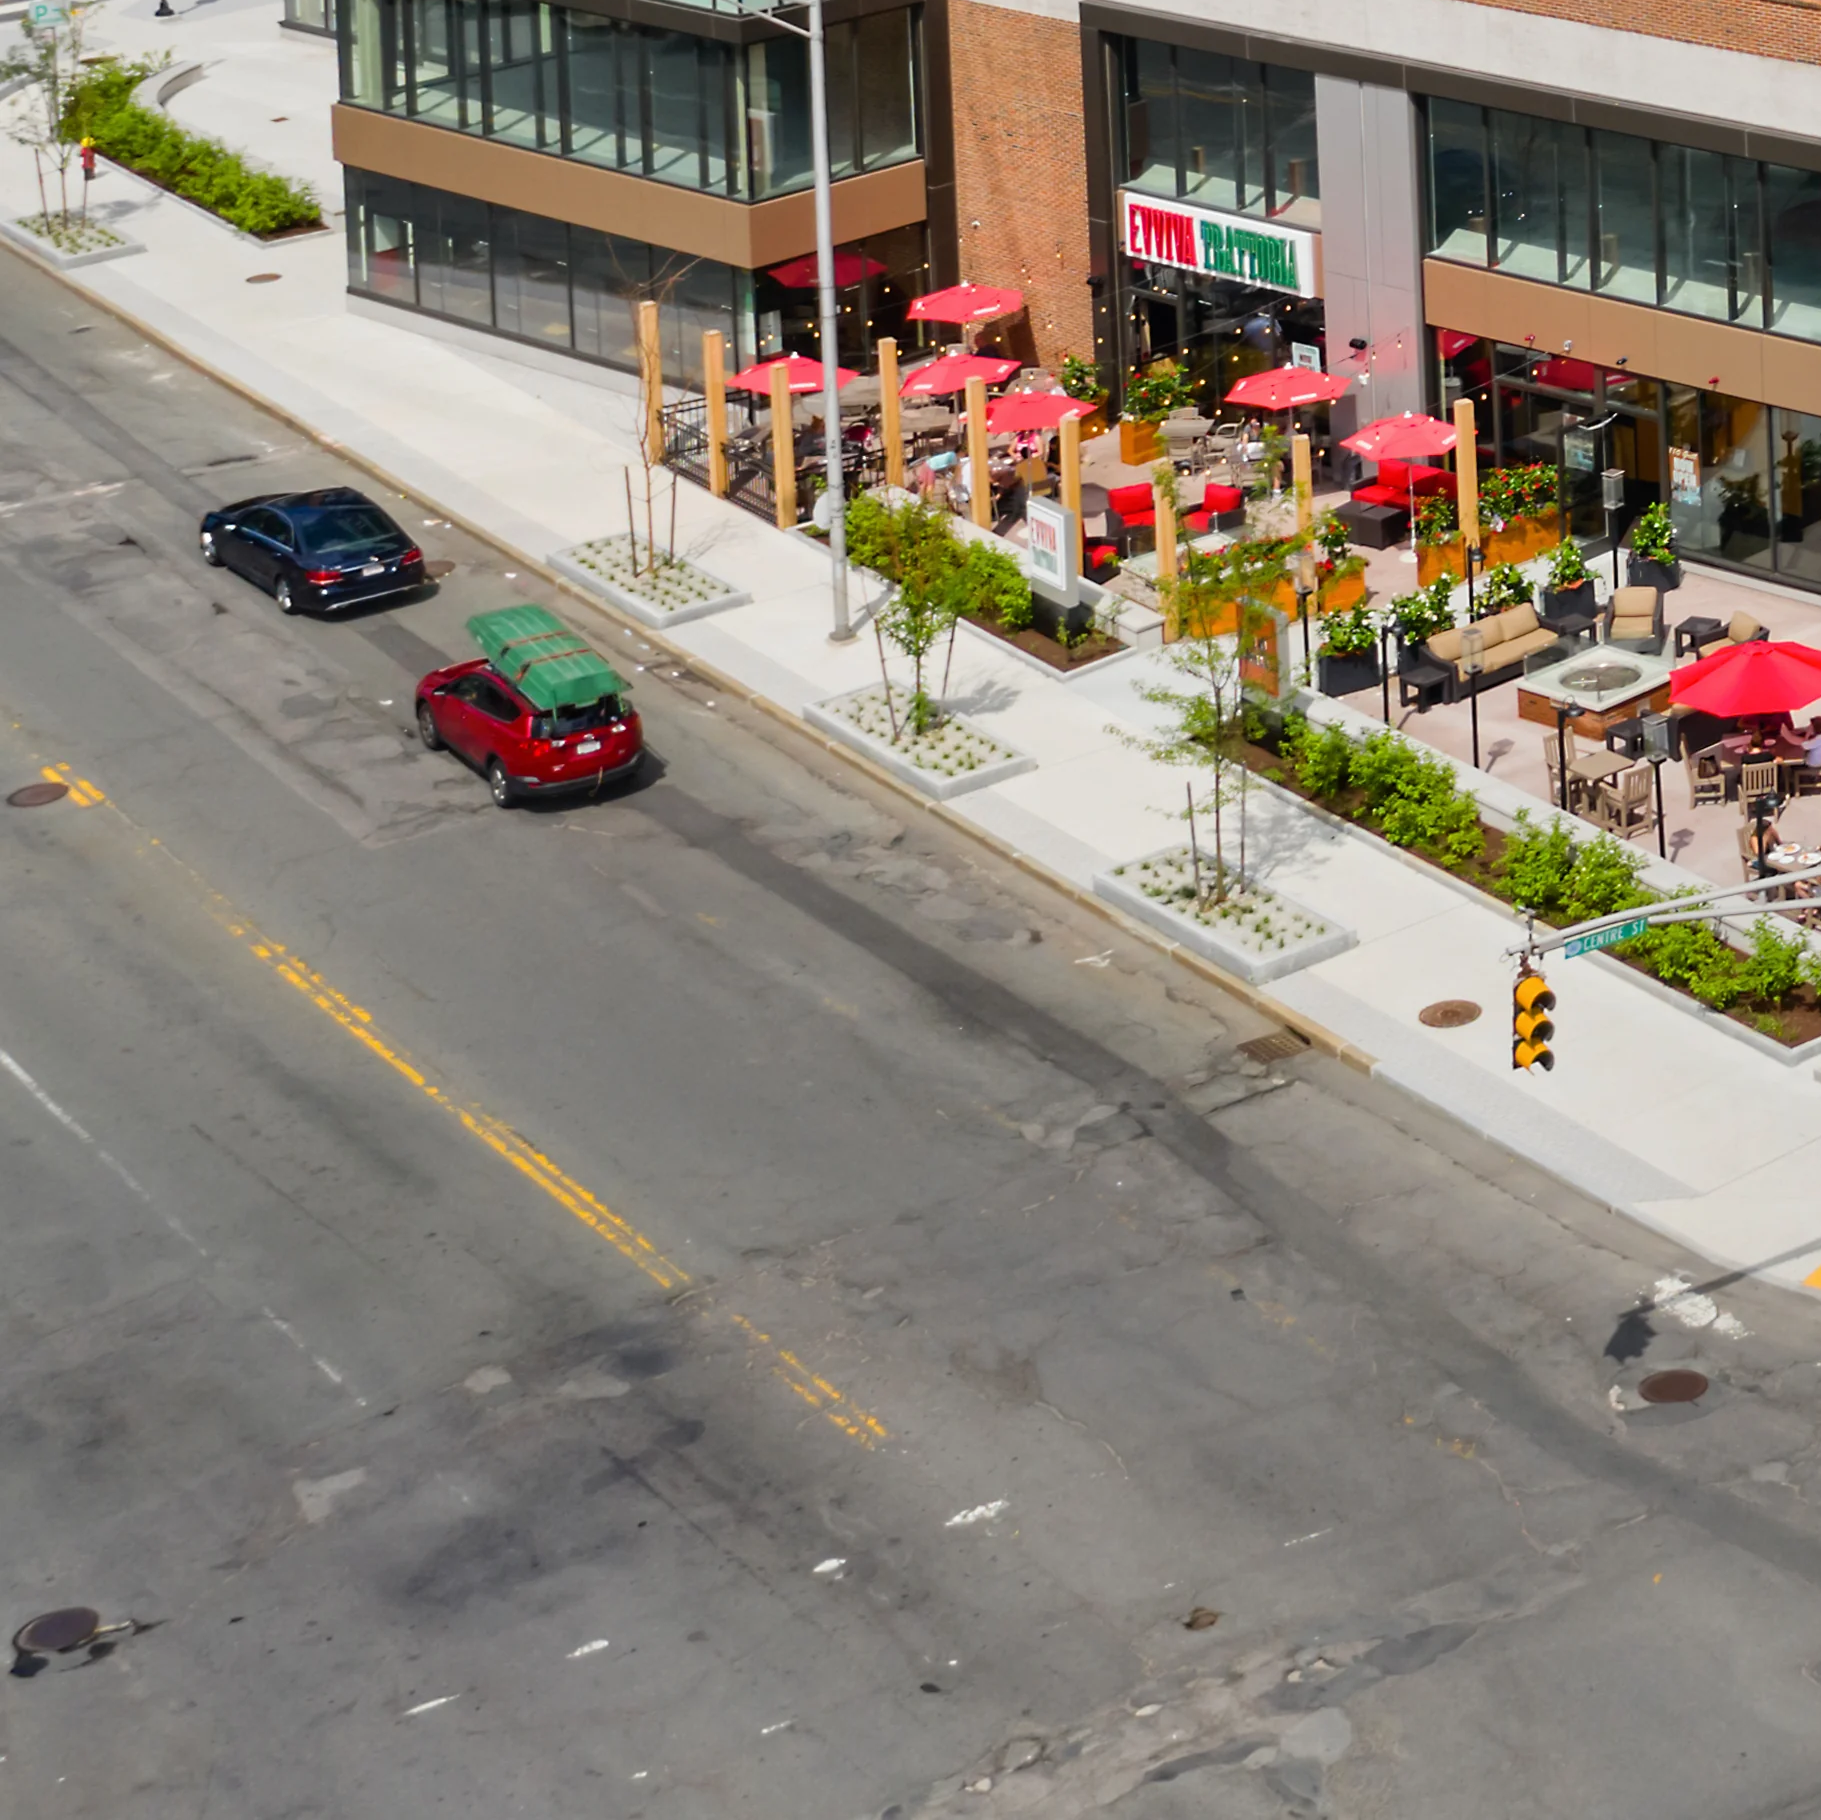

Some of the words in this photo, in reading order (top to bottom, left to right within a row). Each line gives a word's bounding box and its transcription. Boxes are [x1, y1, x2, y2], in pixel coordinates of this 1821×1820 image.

[1129, 203, 1198, 267] EVVIVA
[1200, 219, 1298, 290] TRATTORIA
[1584, 926, 1625, 951] CENTRE
[1631, 919, 1645, 936] ST
